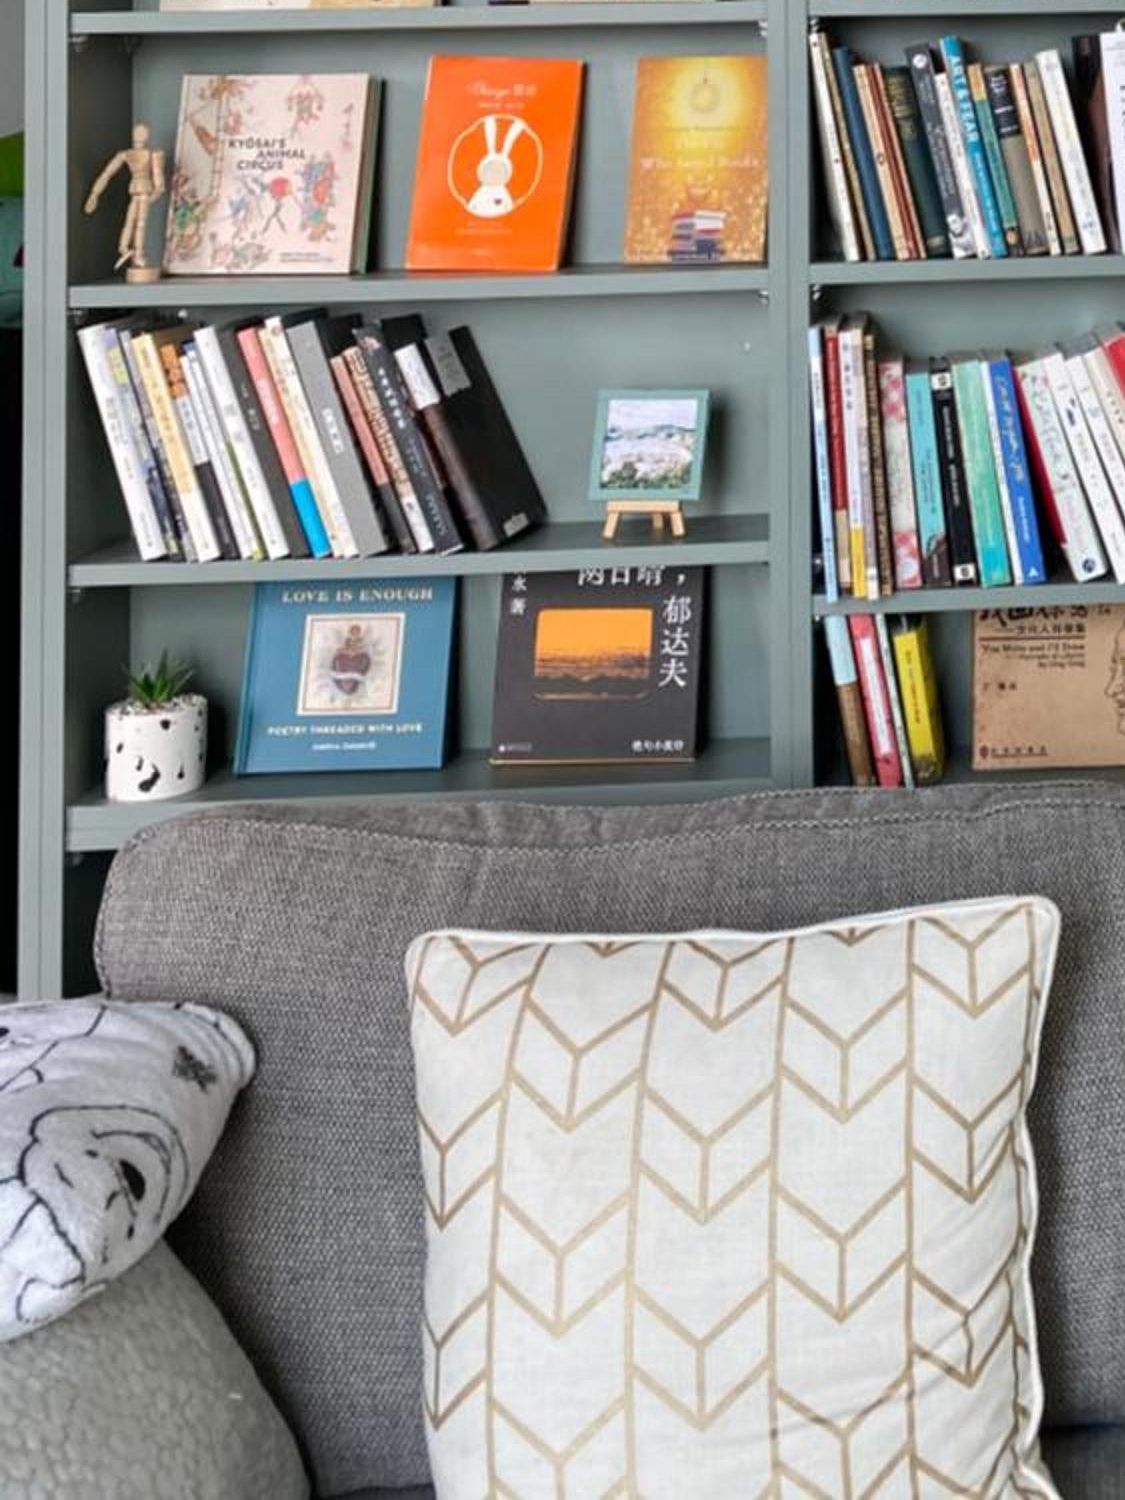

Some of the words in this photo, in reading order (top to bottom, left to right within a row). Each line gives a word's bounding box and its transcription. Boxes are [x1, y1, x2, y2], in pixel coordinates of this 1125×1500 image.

[256, 149, 305, 159] ANIMAL
[237, 159, 283, 170] CIRCUS
[282, 590, 329, 603] LOVE
[335, 590, 353, 602] IS
[359, 588, 433, 602] ENOUGH
[659, 595, 692, 688] 郁达夫
